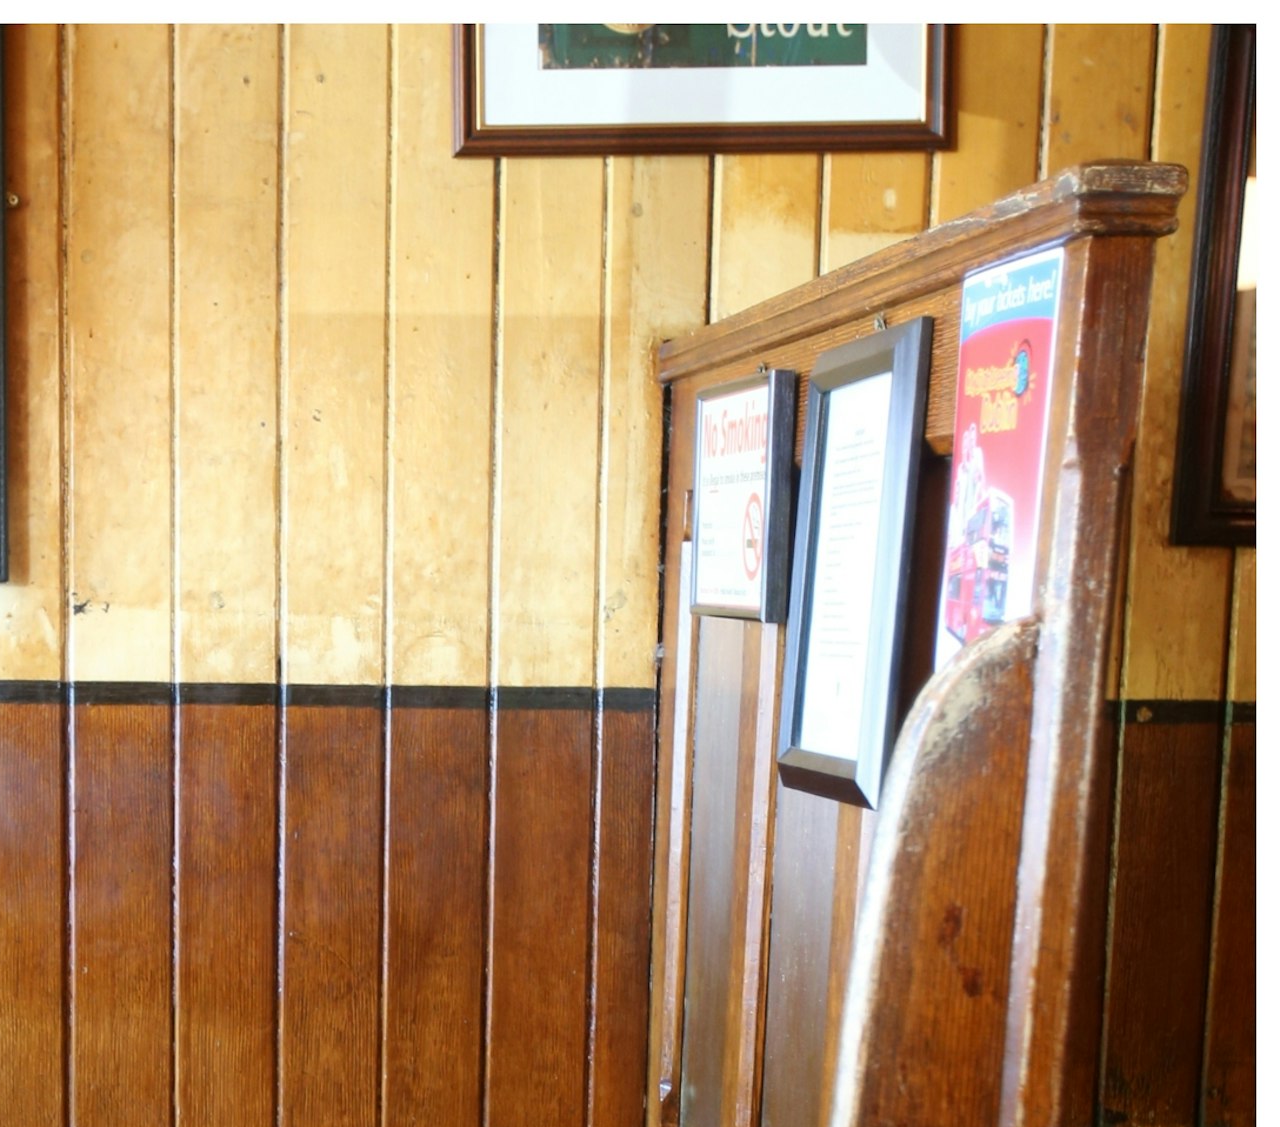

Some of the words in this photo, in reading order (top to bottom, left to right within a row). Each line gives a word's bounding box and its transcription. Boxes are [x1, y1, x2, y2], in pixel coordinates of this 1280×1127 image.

[1027, 269, 1056, 304] here!
[703, 413, 718, 459] No
[720, 399, 768, 465] Smoking
